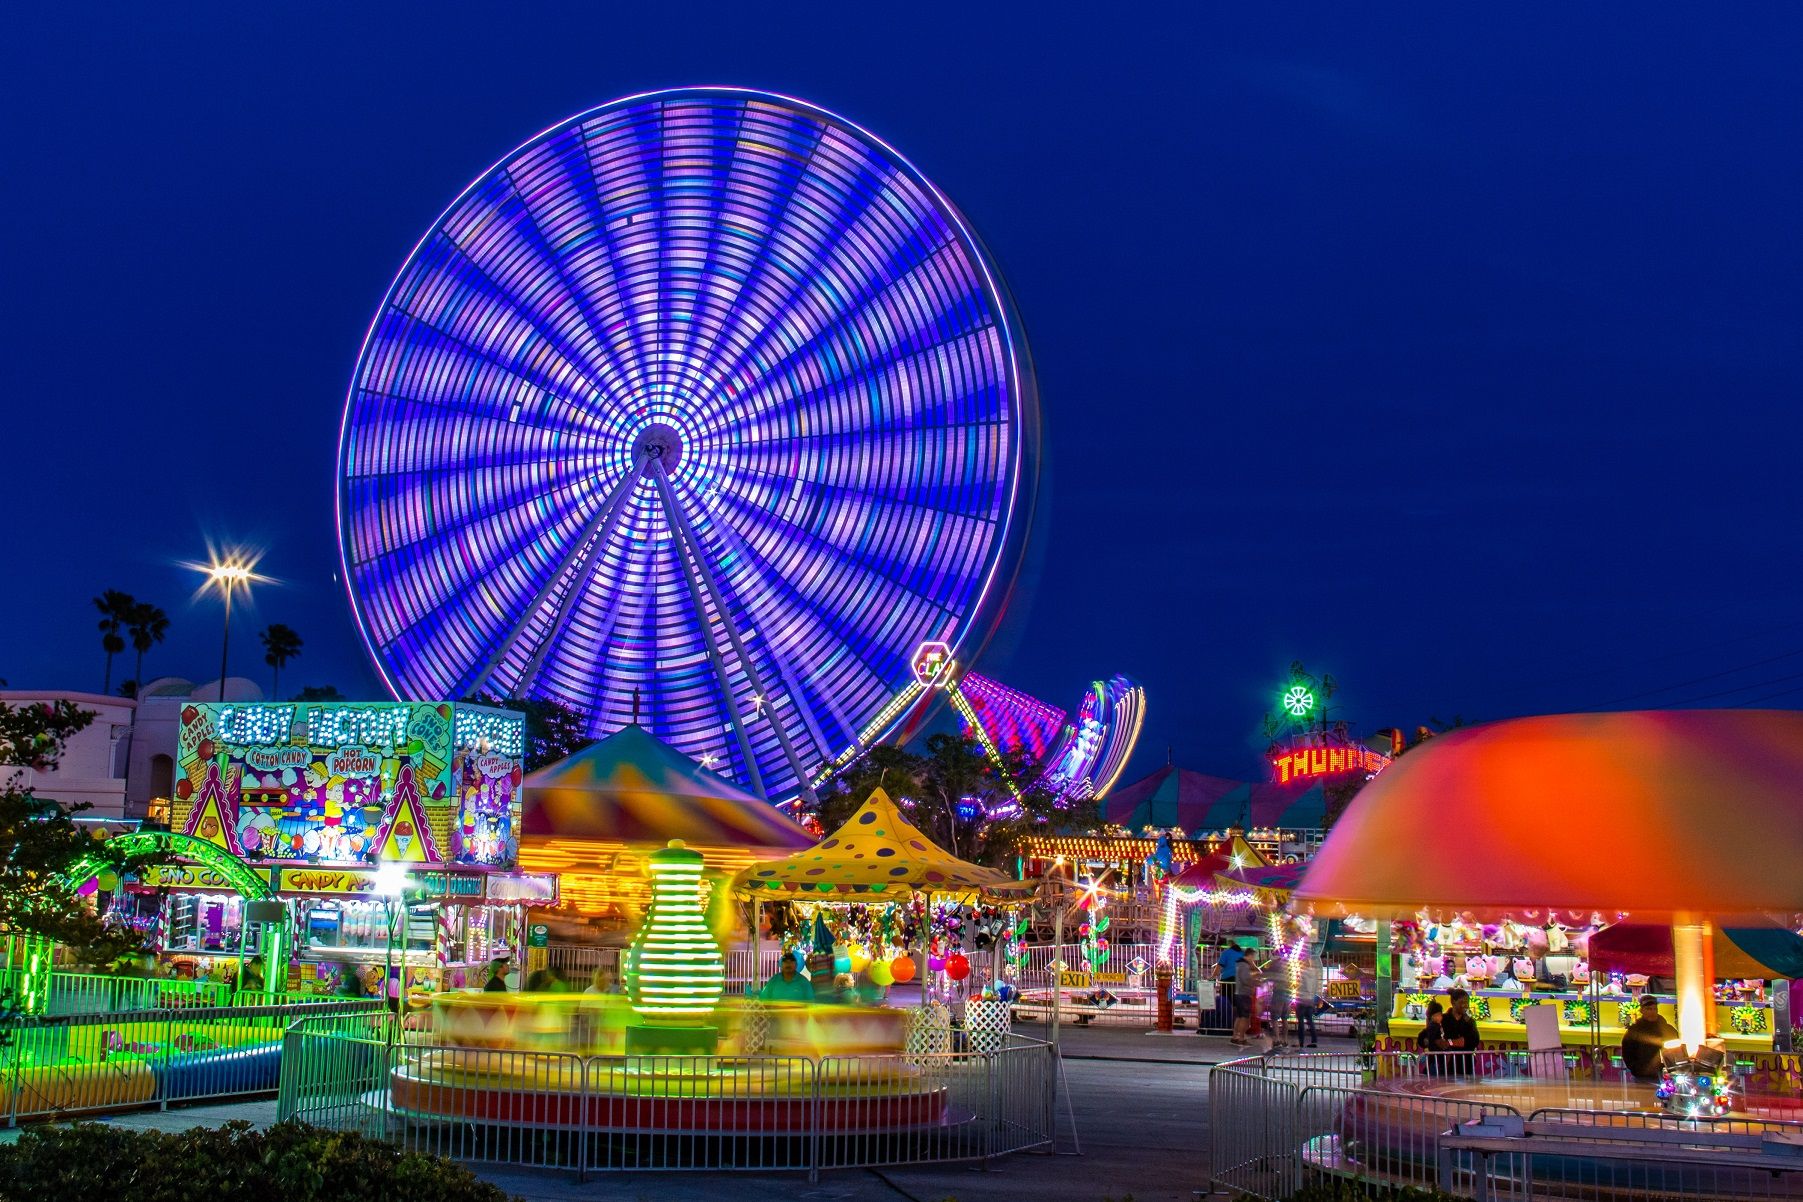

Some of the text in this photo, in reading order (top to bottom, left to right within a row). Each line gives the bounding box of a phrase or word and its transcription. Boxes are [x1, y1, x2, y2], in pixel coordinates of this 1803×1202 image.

[182, 712, 208, 741] CANDY
[219, 704, 413, 746] CANDY FACTORY
[422, 714, 443, 736] SNO
[187, 722, 217, 752] APPLES
[411, 722, 441, 753] CONES
[251, 751, 307, 766] COTTON CANDY
[343, 749, 361, 758] HOT
[333, 758, 375, 773] POPCORN
[480, 758, 499, 767] CANDY
[489, 762, 511, 774] APPLES
[159, 867, 195, 885] SNO
[288, 871, 345, 891] CANDY
[1061, 973, 1087, 987] EXIT
[1330, 982, 1360, 996] ENTER
